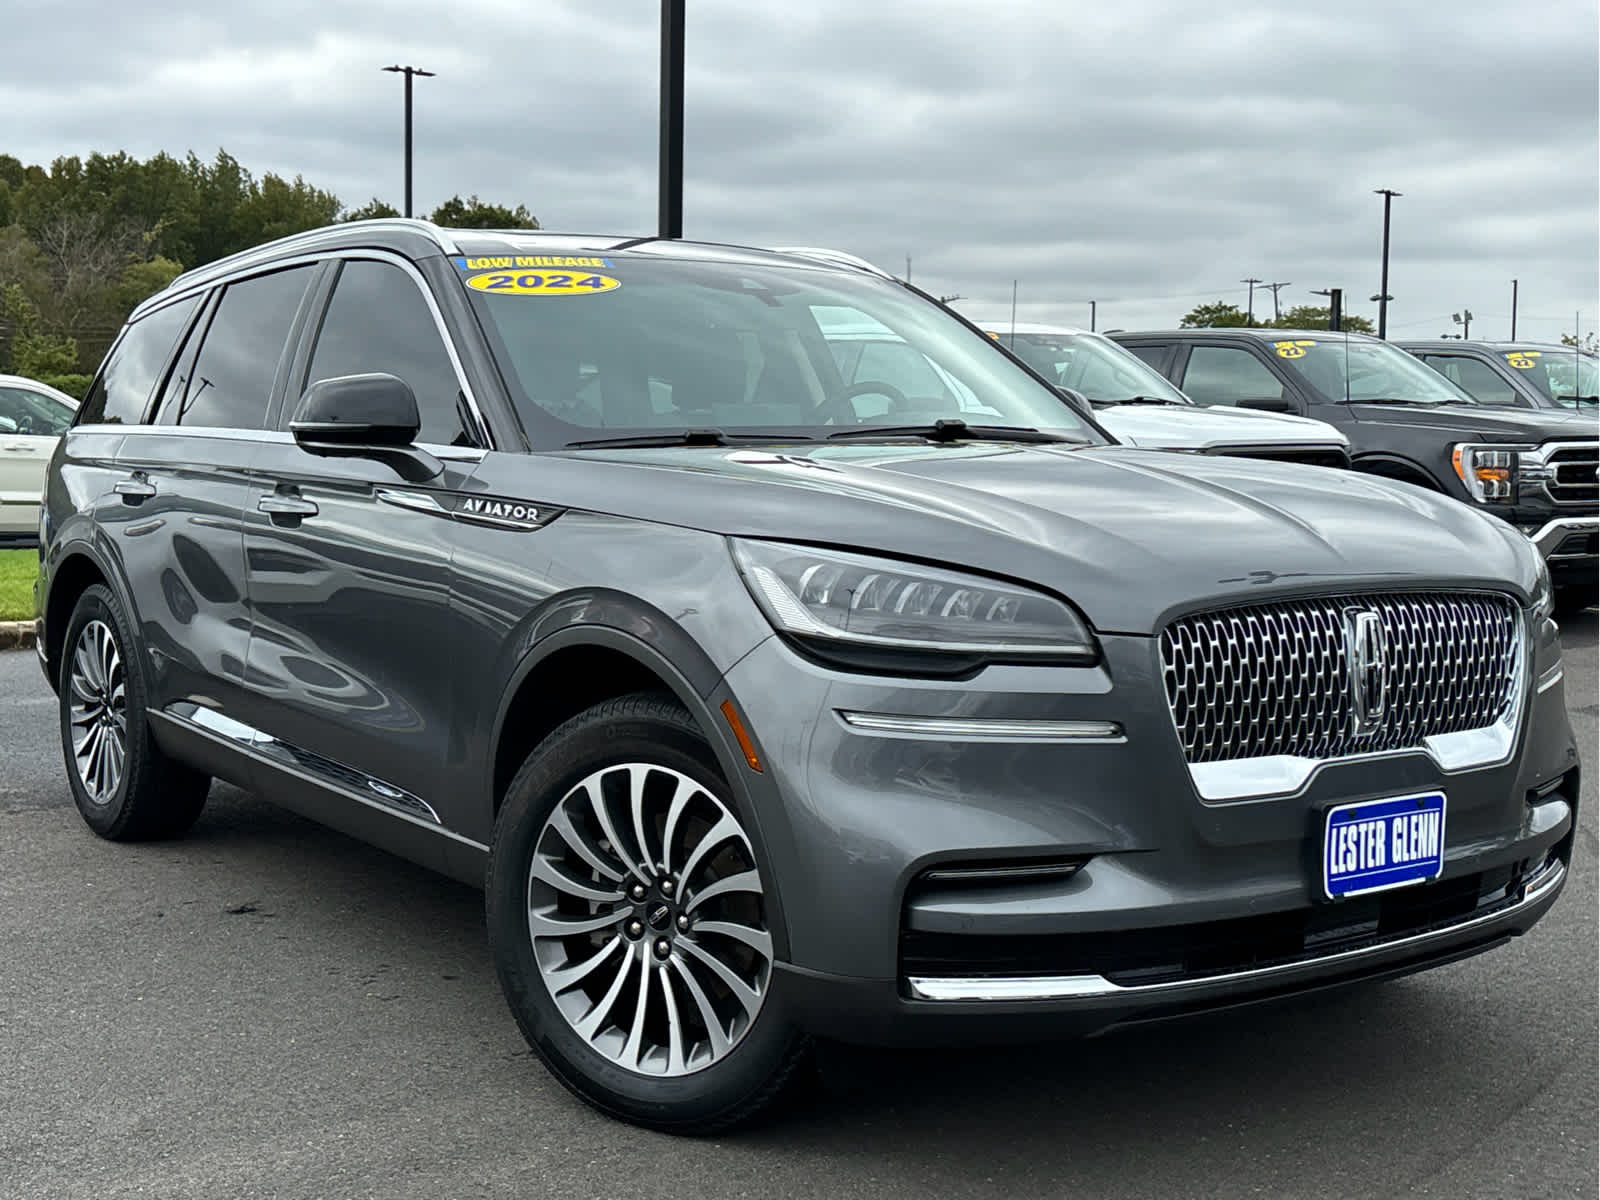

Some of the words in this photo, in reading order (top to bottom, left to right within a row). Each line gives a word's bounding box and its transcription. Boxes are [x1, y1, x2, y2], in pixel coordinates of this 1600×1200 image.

[466, 257, 514, 270] LOW
[515, 256, 606, 268] MILEAGE
[486, 274, 605, 289] 2024
[463, 498, 538, 521] AVIATOR
[1330, 820, 1386, 875] LESTER
[1392, 811, 1440, 864] GLENN
